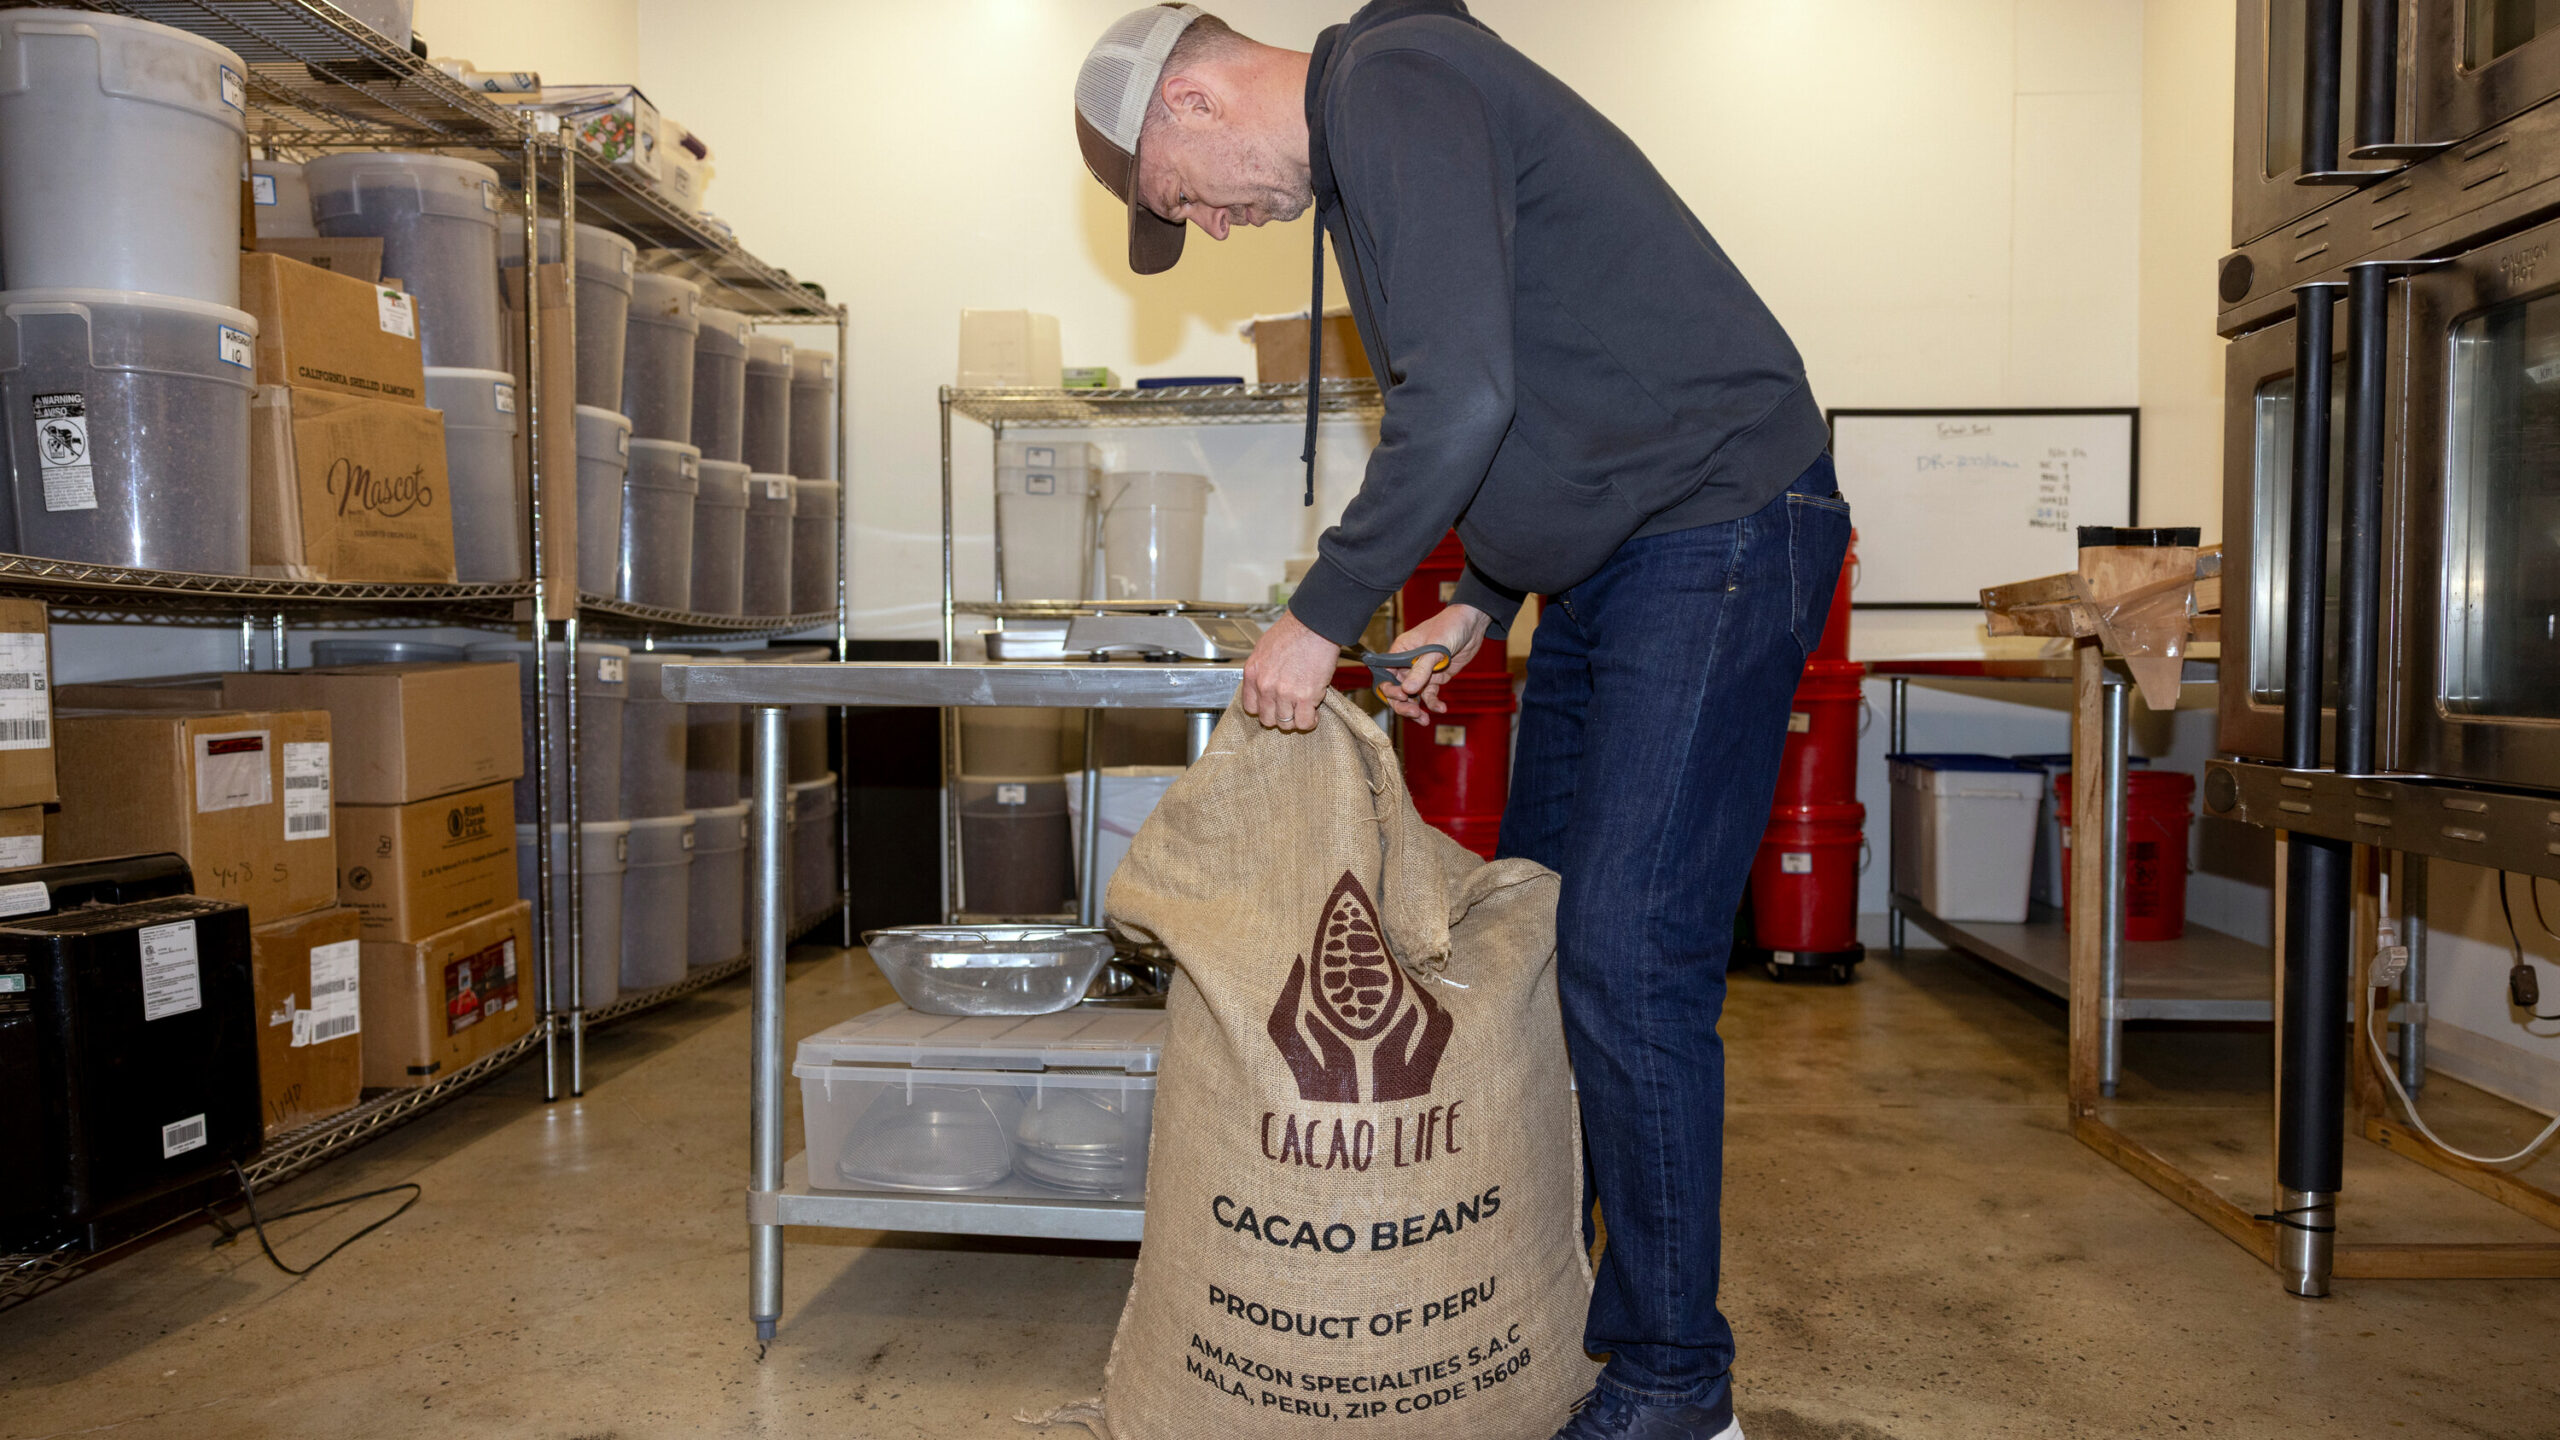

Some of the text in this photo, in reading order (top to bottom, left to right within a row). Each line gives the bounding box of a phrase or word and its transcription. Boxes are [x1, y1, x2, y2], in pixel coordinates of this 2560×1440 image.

[2500, 241, 2548, 270] CAUTION
[2512, 263, 2536, 284] HOT
[231, 348, 241, 363] 10
[41, 394, 82, 405] WARNING
[298, 366, 415, 399] CALIFORNIA SHELLED ALMONDS
[43, 406, 68, 417] AVISO
[326, 457, 433, 518] Mascot
[1261, 1100, 1464, 1172] CACAO LIFE
[1212, 1185, 1501, 1254] CACAO BEANS
[1209, 1276, 1496, 1340] PRODUCT OF PERU
[1191, 1323, 1521, 1394] AMAZON SPECIALTIES S.A.C
[1186, 1347, 1531, 1422] MALA, PERU, ZIP CODE 15608
